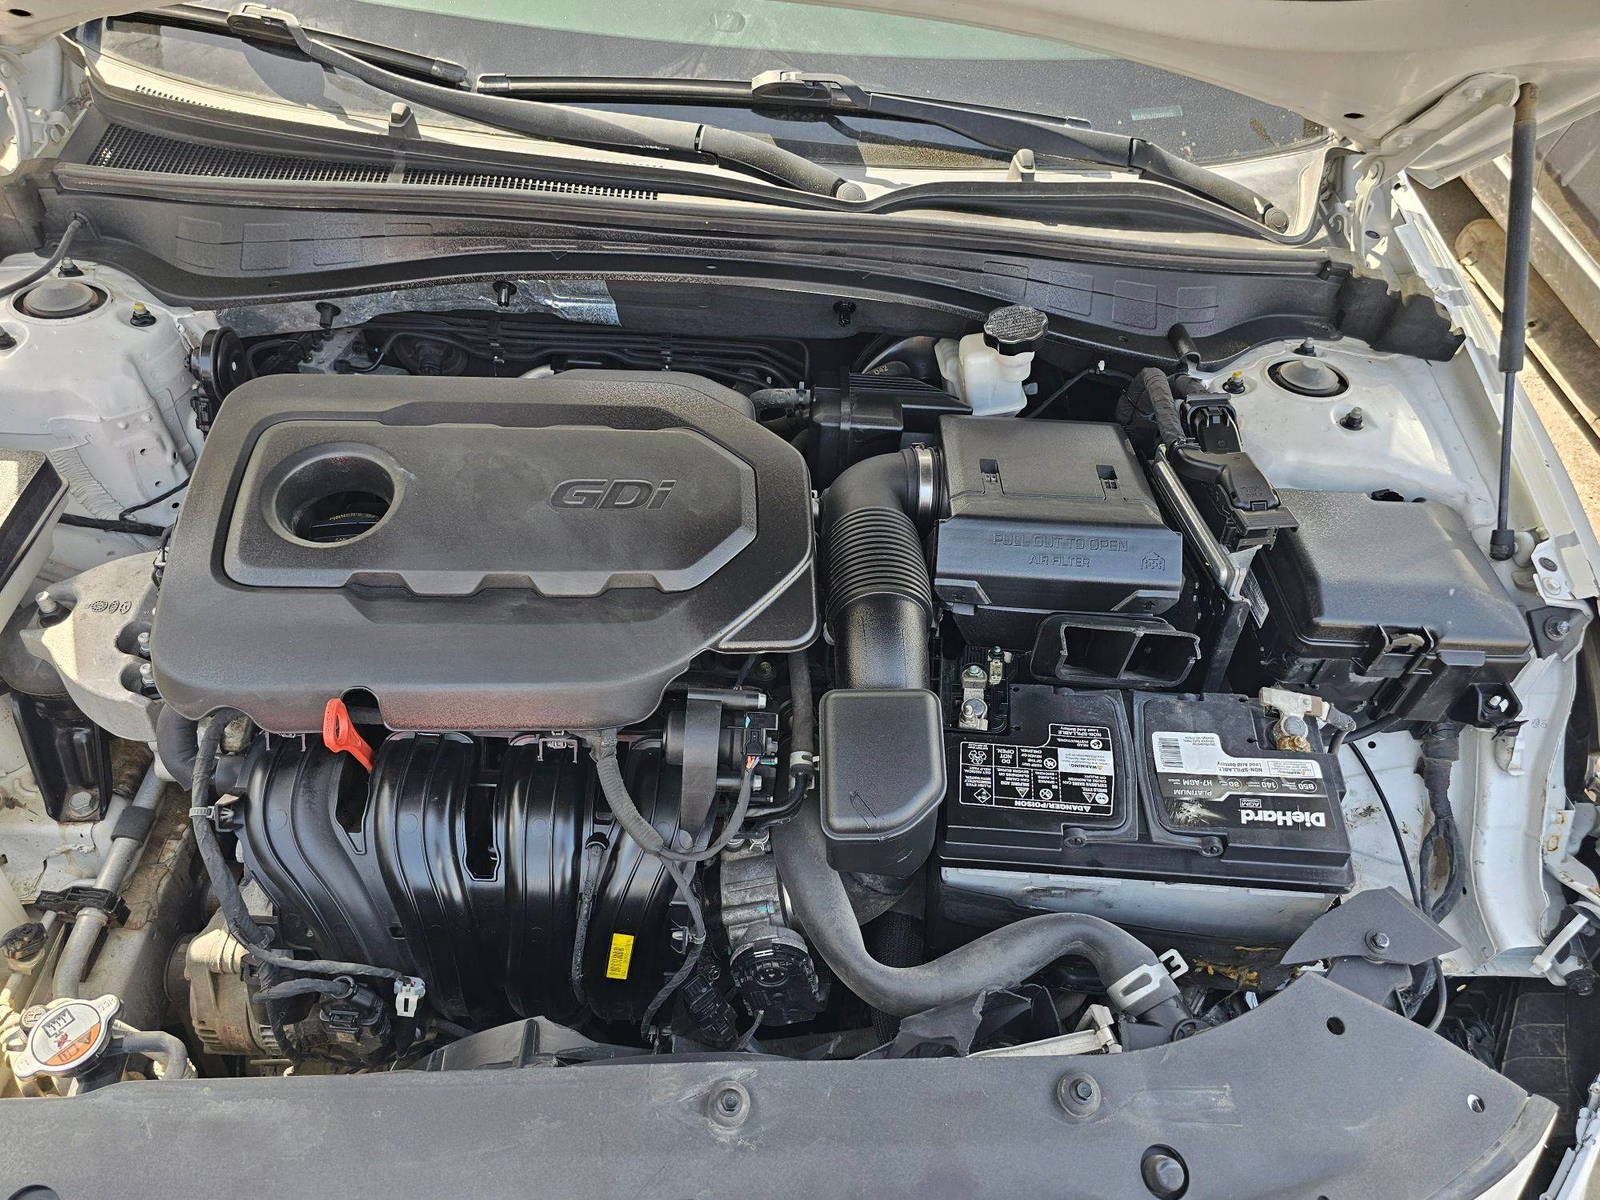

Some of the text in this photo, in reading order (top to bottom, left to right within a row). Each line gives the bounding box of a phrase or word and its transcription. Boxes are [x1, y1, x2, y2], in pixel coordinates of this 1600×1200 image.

[549, 478, 678, 511] GDi
[992, 533, 1128, 552] PULL OUT TO OPEN
[1029, 552, 1092, 568] AIR FILTER
[1015, 800, 1083, 810] DANGER/POISON
[1240, 809, 1326, 828] DieHard
